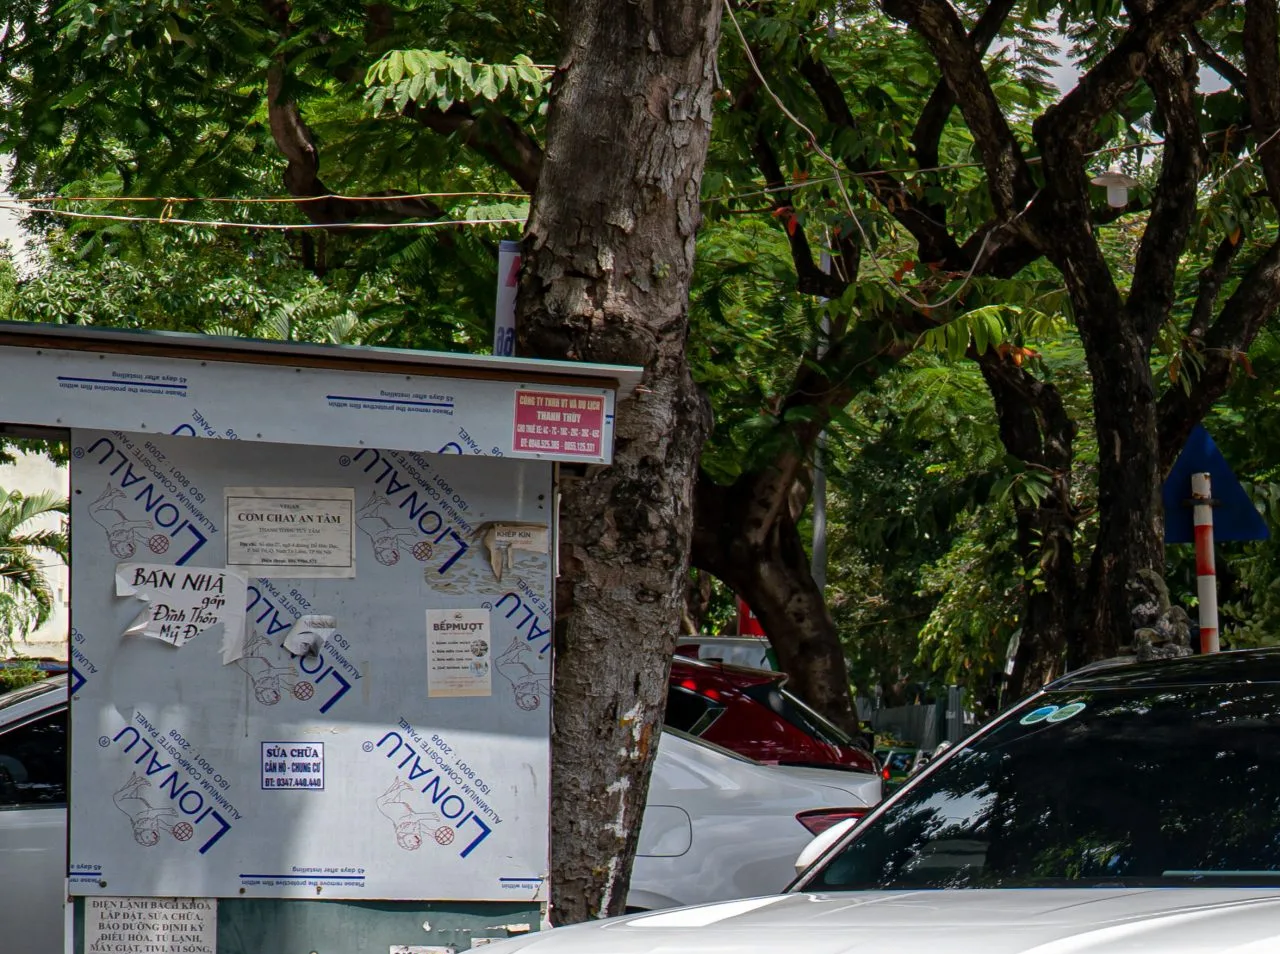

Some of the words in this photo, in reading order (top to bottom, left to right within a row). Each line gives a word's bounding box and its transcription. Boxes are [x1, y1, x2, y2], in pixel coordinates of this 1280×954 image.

[537, 411, 560, 421] THANH
[143, 441, 165, 462] 2008
[132, 448, 177, 492] COMPOSITE
[168, 467, 189, 486] 9001
[396, 456, 440, 500] COMPOSITE
[188, 486, 205, 502] ISO
[451, 494, 468, 509] ISO
[175, 492, 217, 533] ALUMINIUM
[238, 512, 263, 522] CƠM
[267, 513, 296, 522] CHAY
[300, 515, 313, 523] AN
[317, 513, 341, 523] TÂM
[132, 567, 176, 588] BÁN
[181, 573, 226, 593] NHÀ
[289, 589, 311, 608] 2008
[153, 604, 185, 621] Đình
[191, 607, 217, 624] Thôn
[160, 624, 181, 645] Mỹ
[333, 633, 350, 649] ISO
[132, 711, 159, 736] PANEL
[395, 716, 422, 742] PANEL
[168, 729, 190, 749] 2008
[430, 734, 452, 754] 2008
[157, 736, 202, 780] COMPOSITE
[267, 745, 287, 757] SỬA
[291, 747, 318, 757] CHỮA
[193, 754, 214, 774] 9001
[291, 762, 311, 772] CHUNG
[312, 762, 320, 772] CƯ
[419, 741, 463, 784] COMPOSITE
[454, 759, 475, 778] 9001
[213, 773, 230, 789] ISO
[473, 778, 491, 794] ISO
[199, 779, 242, 820] ALUMINIUM
[460, 783, 502, 824] ALUMINIUM
[162, 924, 188, 933] ĐỊNH
